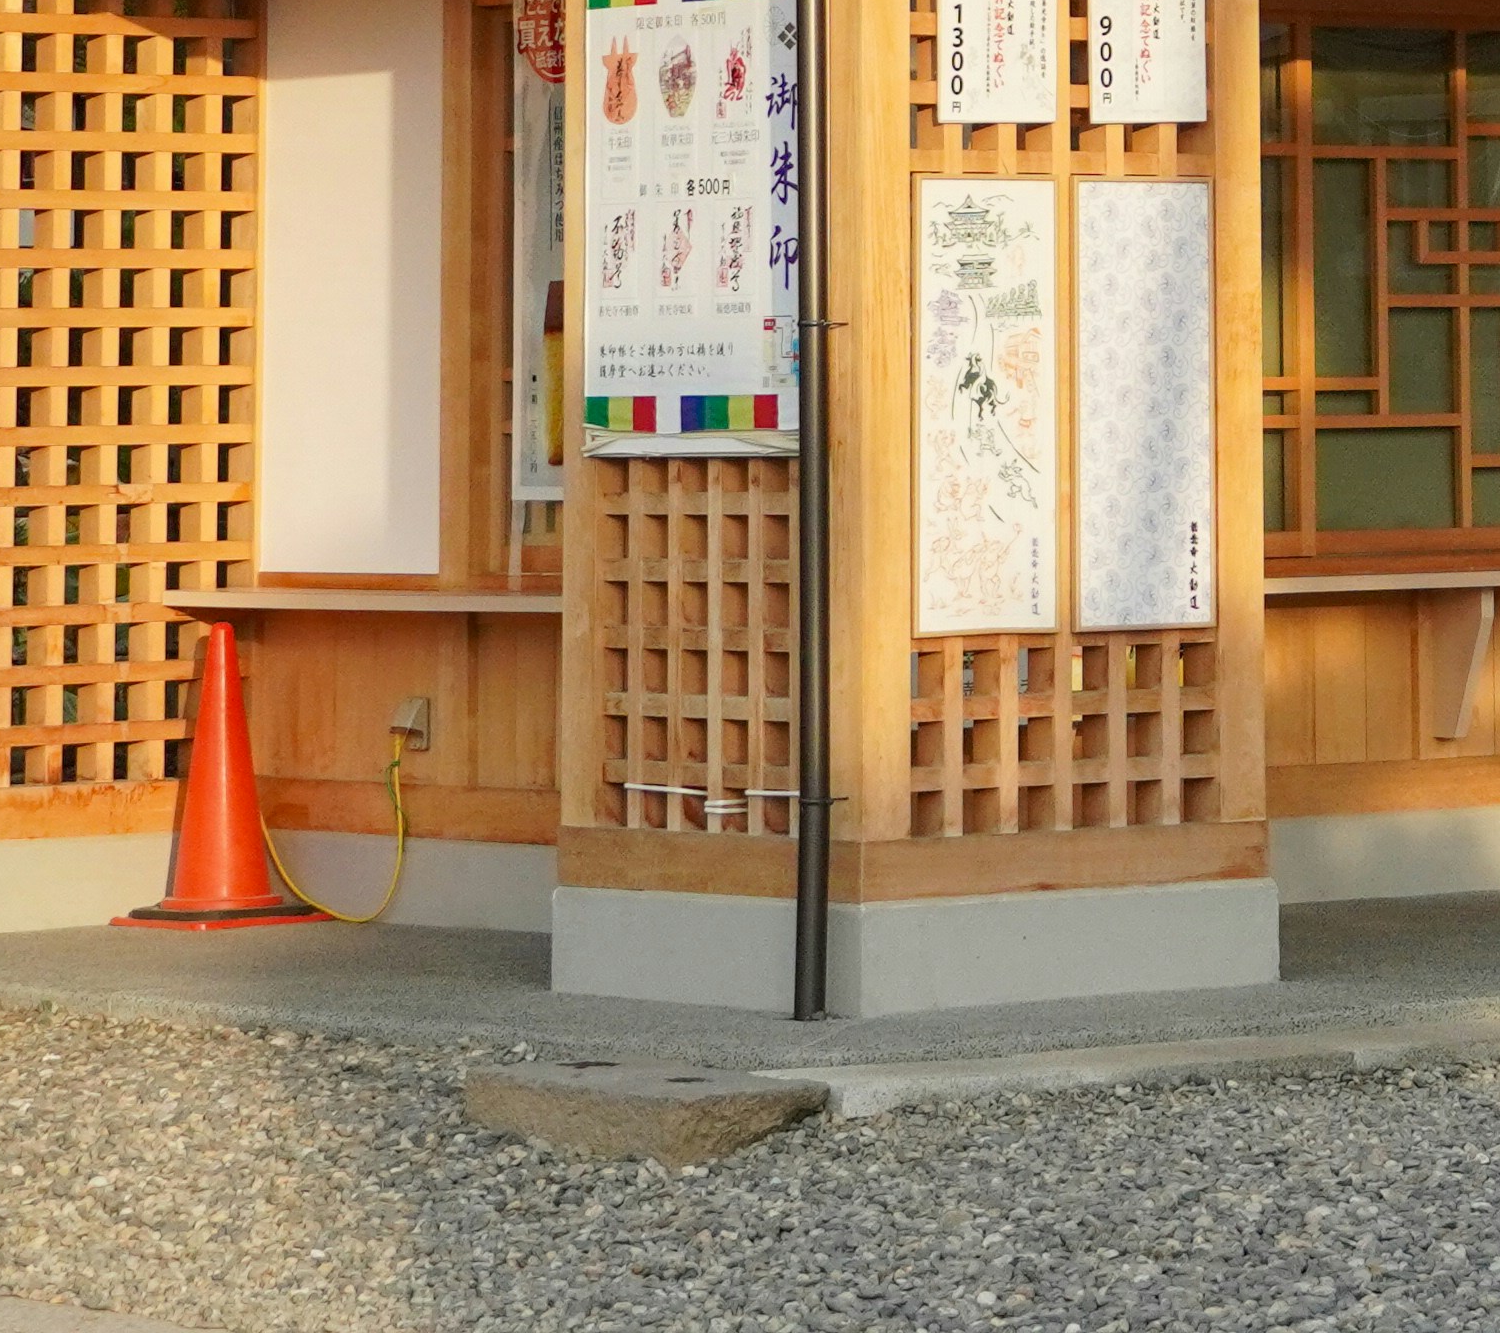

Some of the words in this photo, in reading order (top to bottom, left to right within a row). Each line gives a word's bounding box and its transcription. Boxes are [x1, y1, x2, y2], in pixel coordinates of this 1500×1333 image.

[951, 3, 964, 113] 1300円
[1100, 16, 1113, 104] 900円
[686, 178, 731, 197] 各500円
